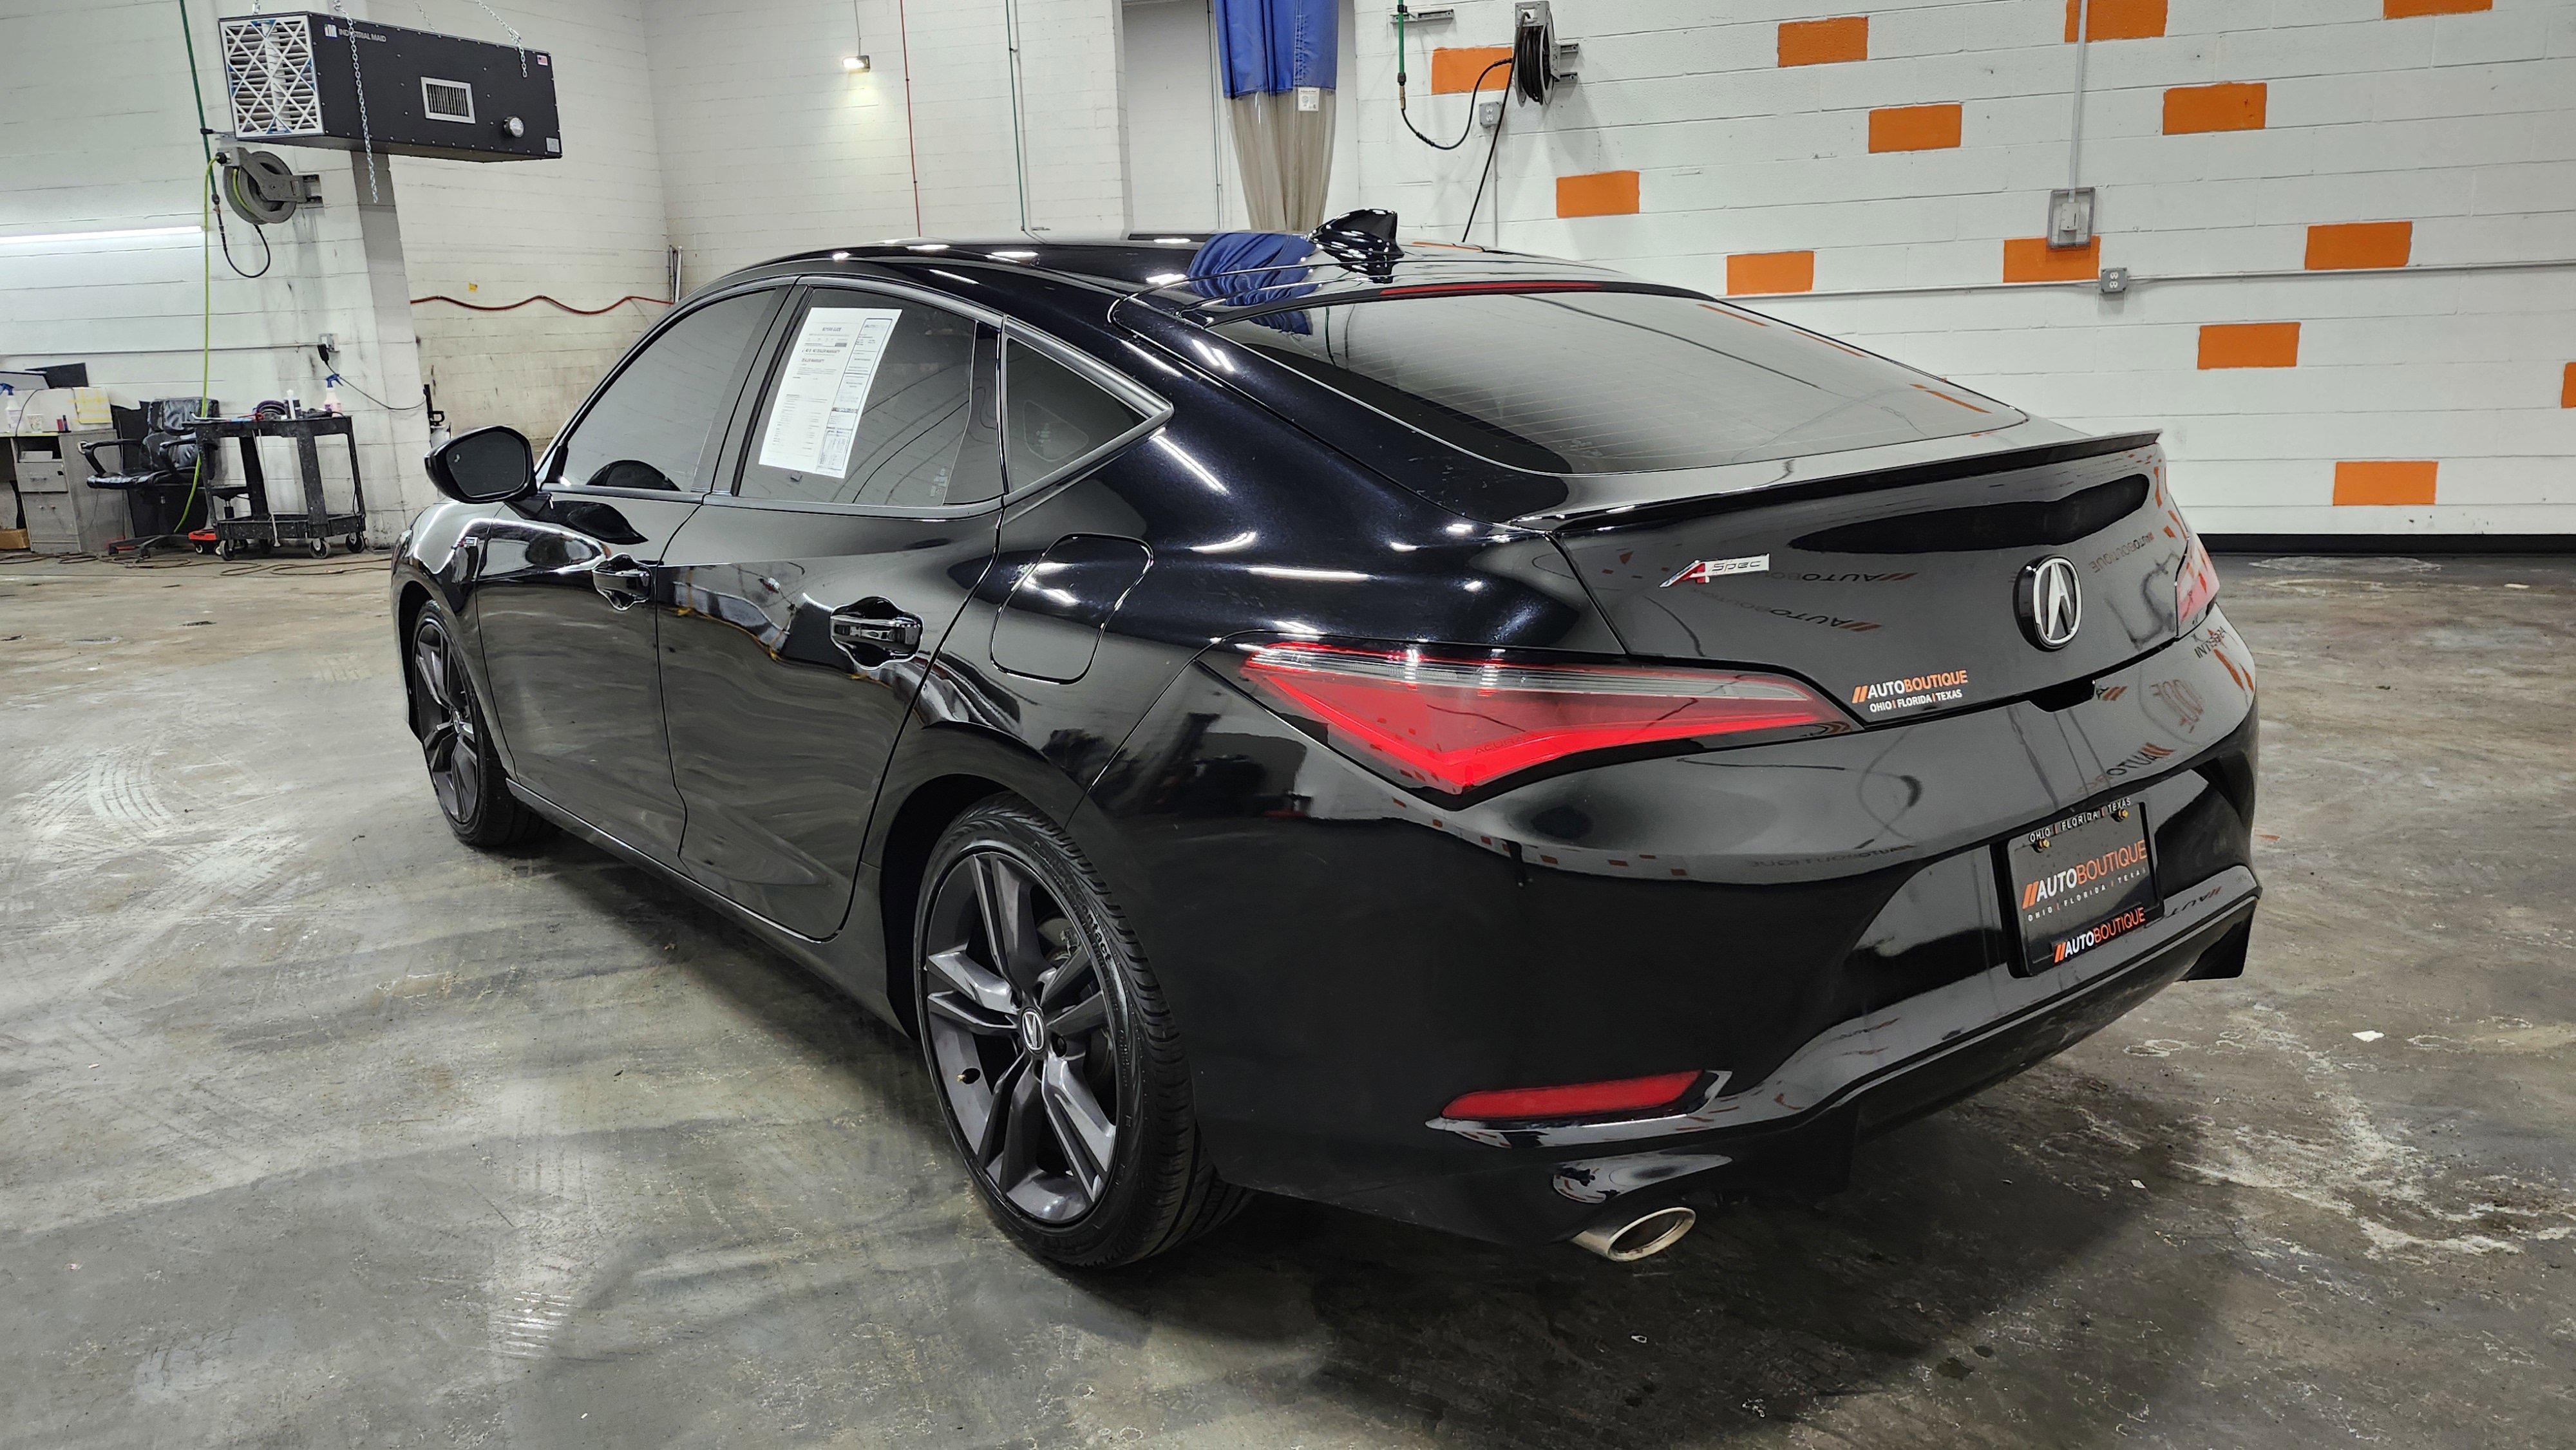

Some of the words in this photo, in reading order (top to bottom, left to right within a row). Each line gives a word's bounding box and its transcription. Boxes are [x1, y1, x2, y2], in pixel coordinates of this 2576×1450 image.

[338, 28, 371, 40] INDSTRIAL
[371, 33, 386, 42] MAID
[1867, 670, 1969, 699] AUTOBOUTIQUE
[1869, 701, 1892, 713] OHIO
[1897, 694, 1933, 708] FLORIDA
[1937, 689, 1963, 702] TEXAS
[2029, 827, 2050, 843] OHIO
[2061, 811, 2098, 831] FLORIDA
[2107, 797, 2131, 813] TEXAS
[2036, 839, 2148, 903] AUTOBOUTIQUE
[2028, 906, 2053, 922] OHIO
[2064, 884, 2107, 907] FLORIDA
[2065, 907, 2146, 958] AUTOBOUTIQUE
